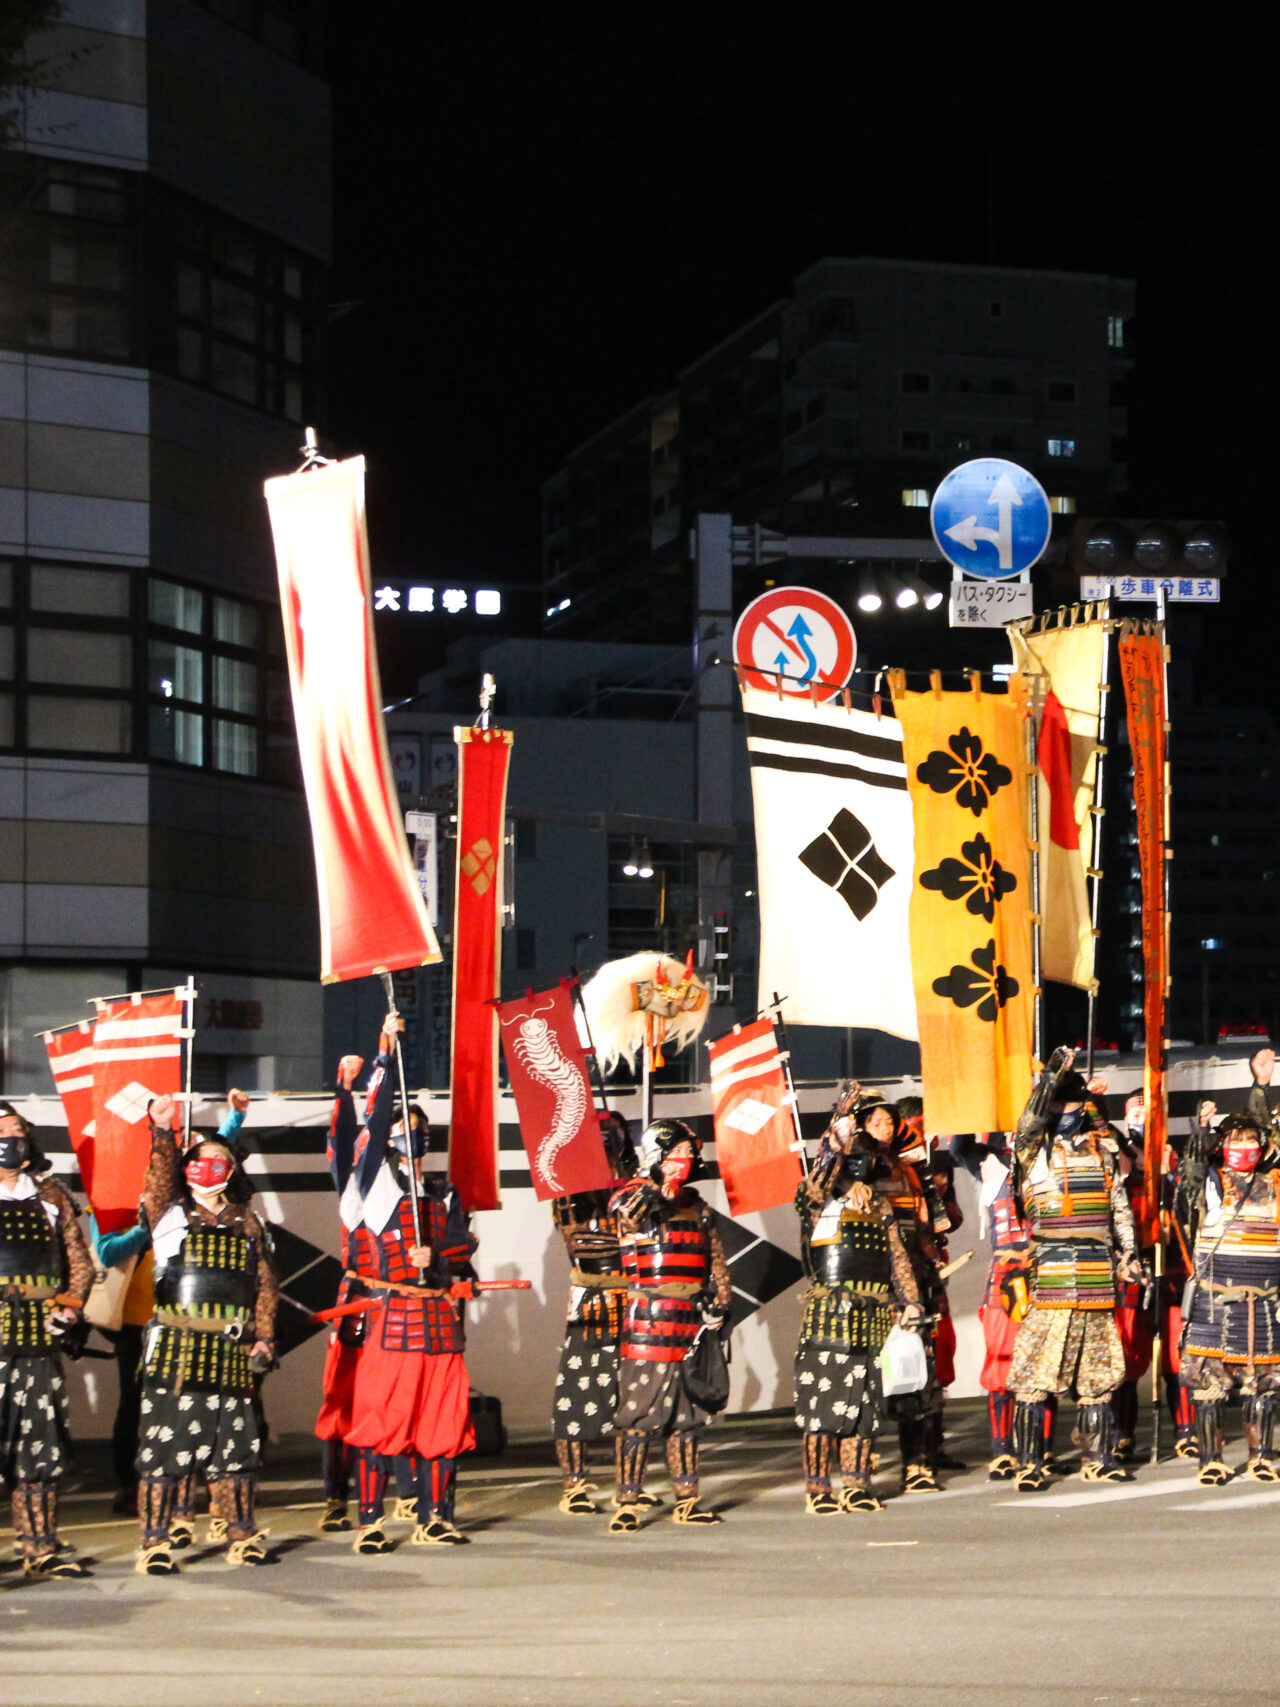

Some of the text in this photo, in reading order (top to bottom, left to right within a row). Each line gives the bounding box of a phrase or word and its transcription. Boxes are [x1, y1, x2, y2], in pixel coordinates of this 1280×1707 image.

[956, 586, 1027, 603] バス・タクシー
[1121, 578, 1213, 597] 歩車分離式
[957, 608, 988, 623] を除く
